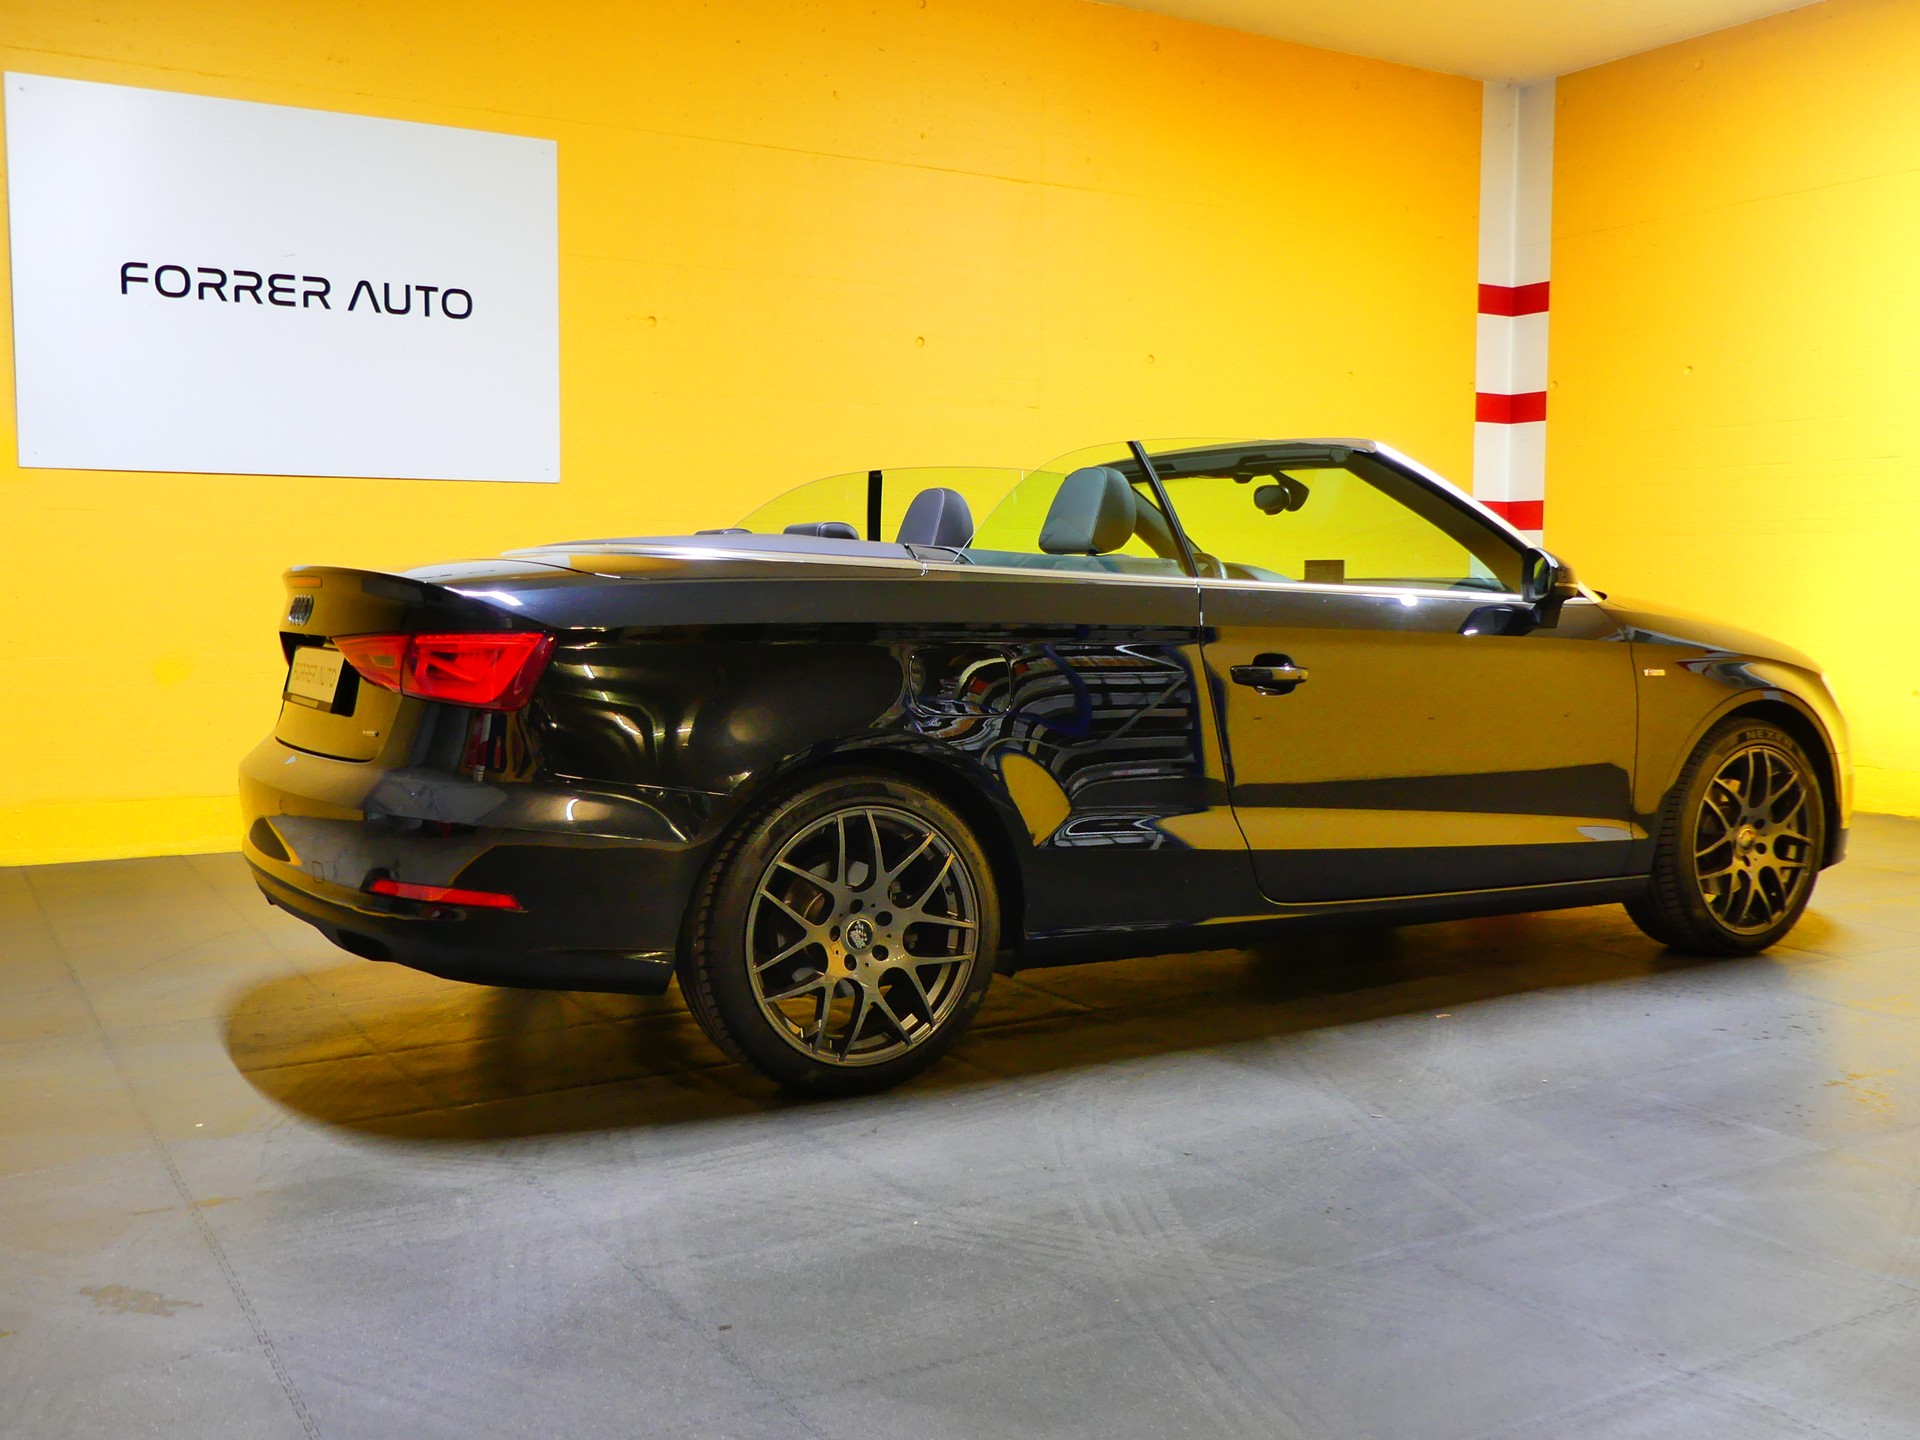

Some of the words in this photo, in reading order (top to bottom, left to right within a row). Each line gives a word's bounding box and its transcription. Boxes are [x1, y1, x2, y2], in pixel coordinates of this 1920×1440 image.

[121, 262, 331, 310] FORRER
[348, 280, 473, 319] AUTO
[318, 665, 338, 688] AUTO
